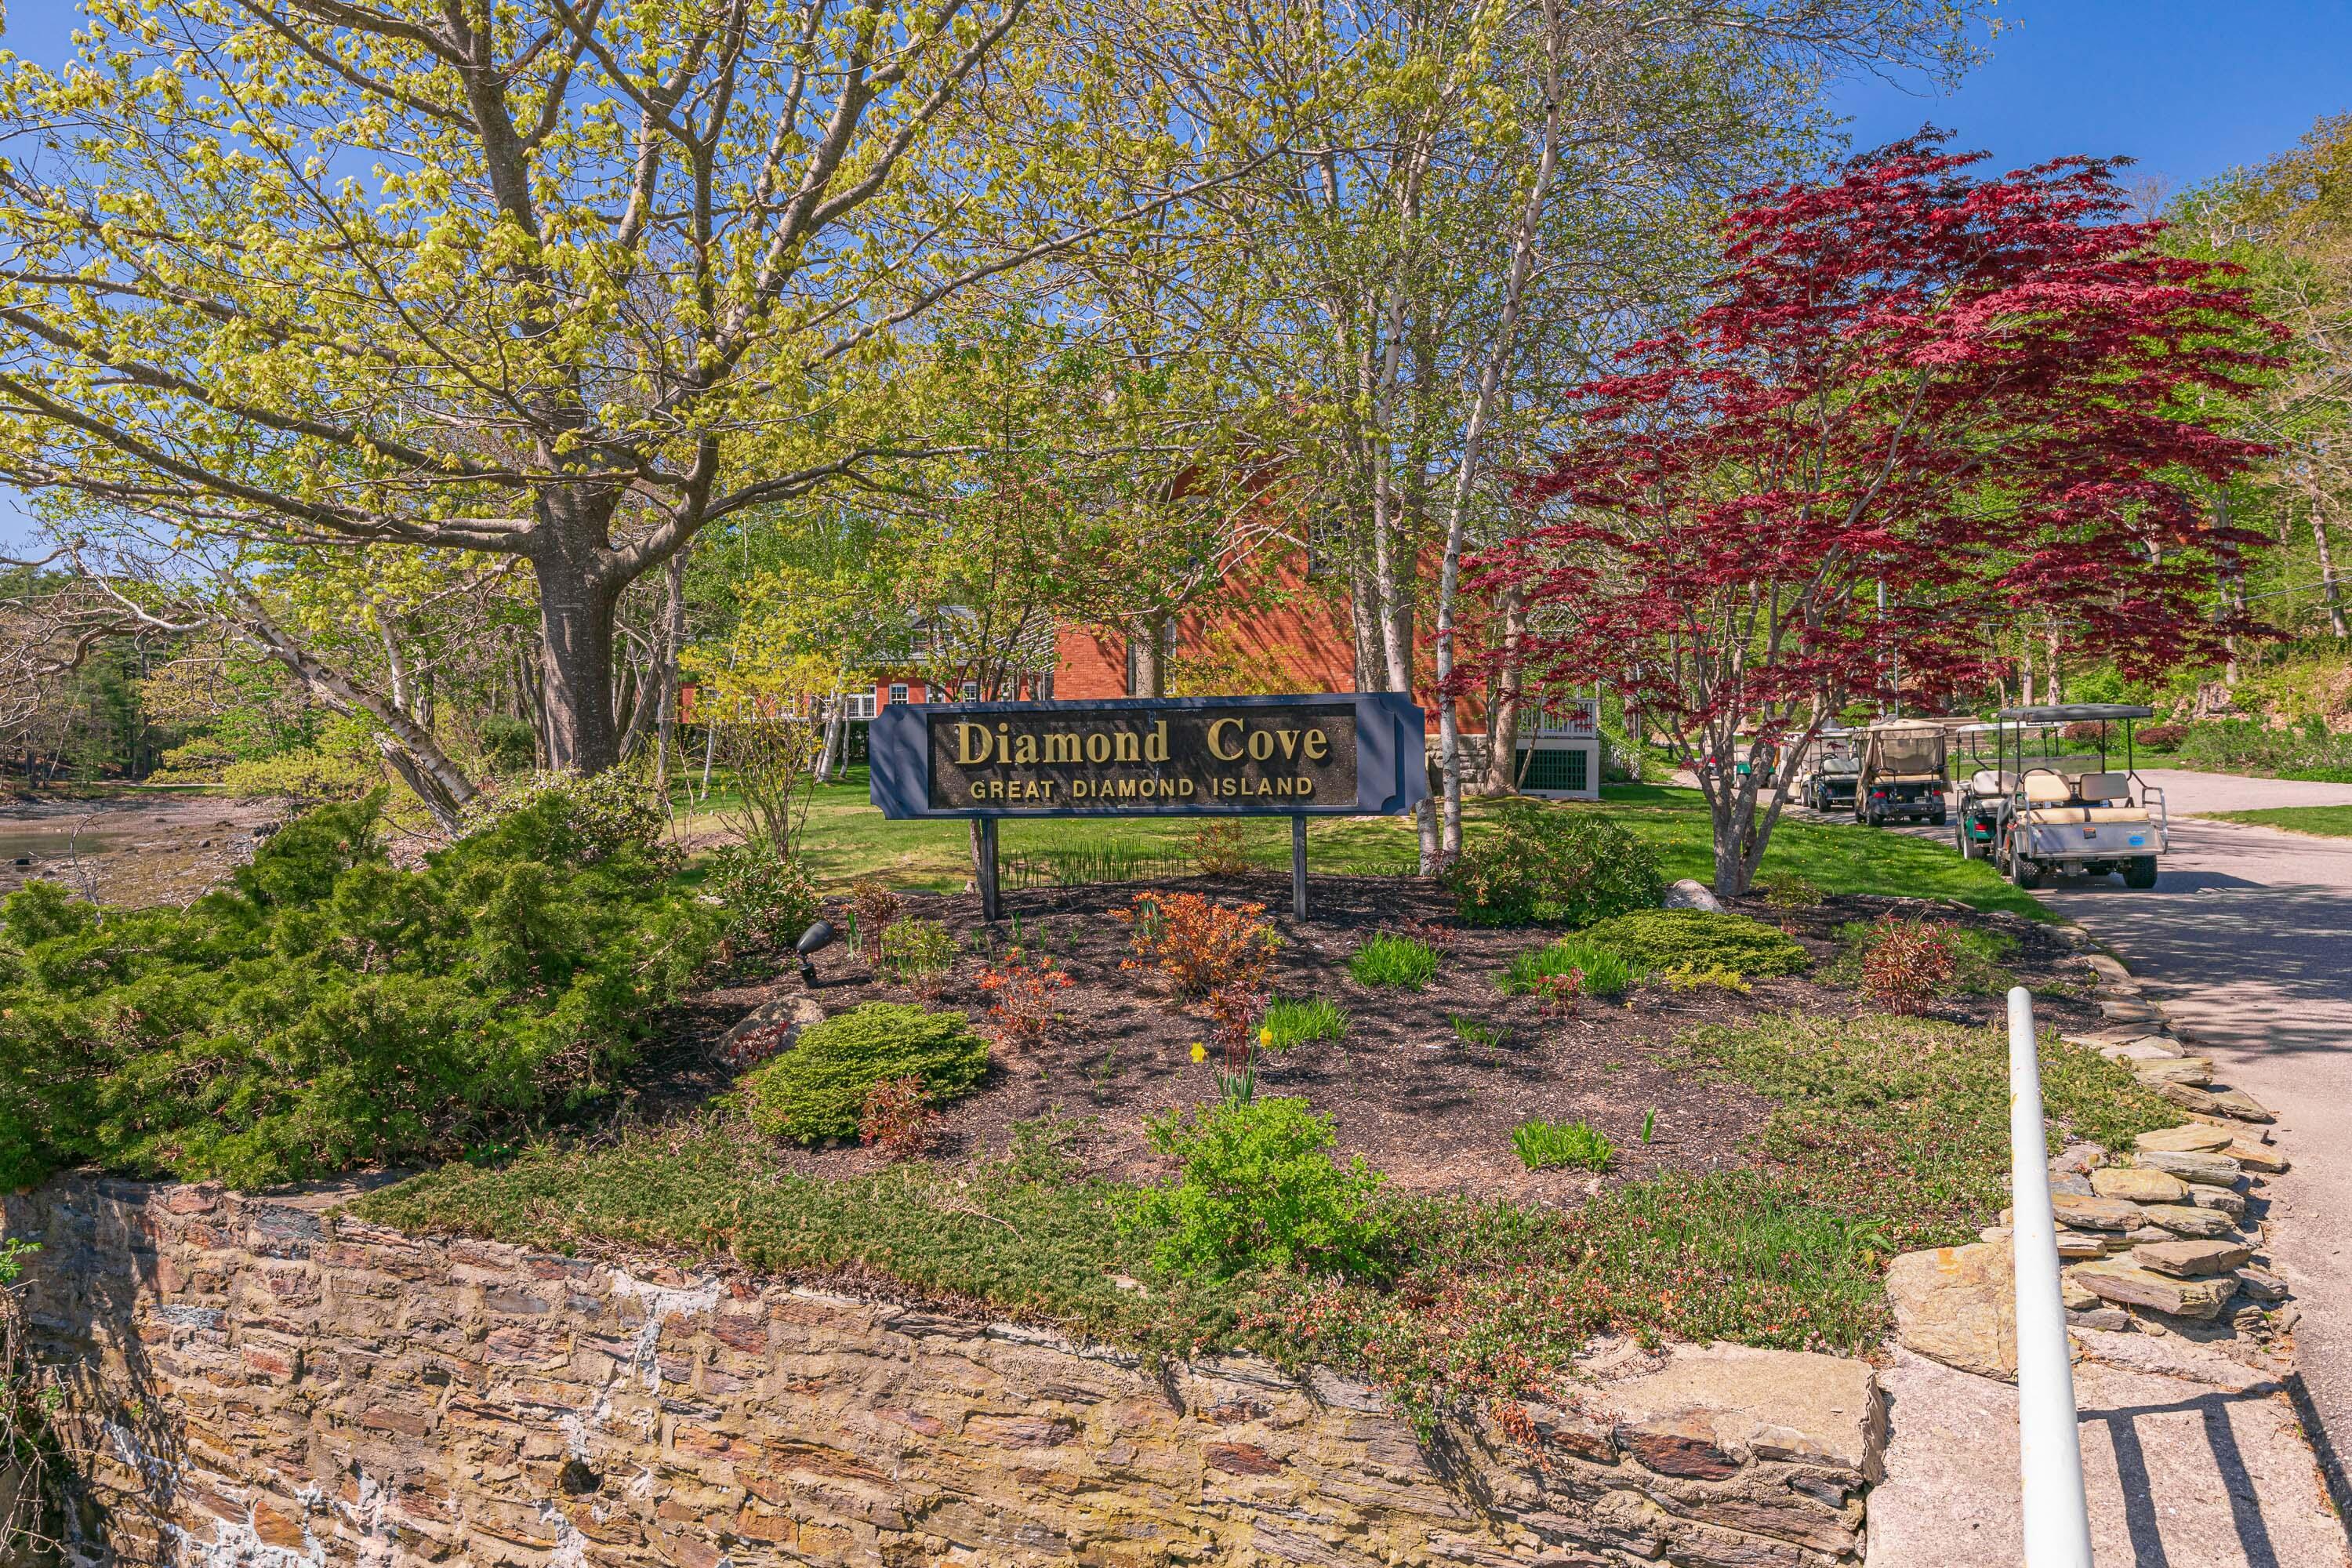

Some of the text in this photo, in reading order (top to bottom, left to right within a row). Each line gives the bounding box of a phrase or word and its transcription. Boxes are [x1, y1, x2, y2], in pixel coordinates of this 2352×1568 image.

[954, 718, 1327, 764] Diamond Cove
[970, 777, 1313, 799] GREAT DIAMOND ISLAND
